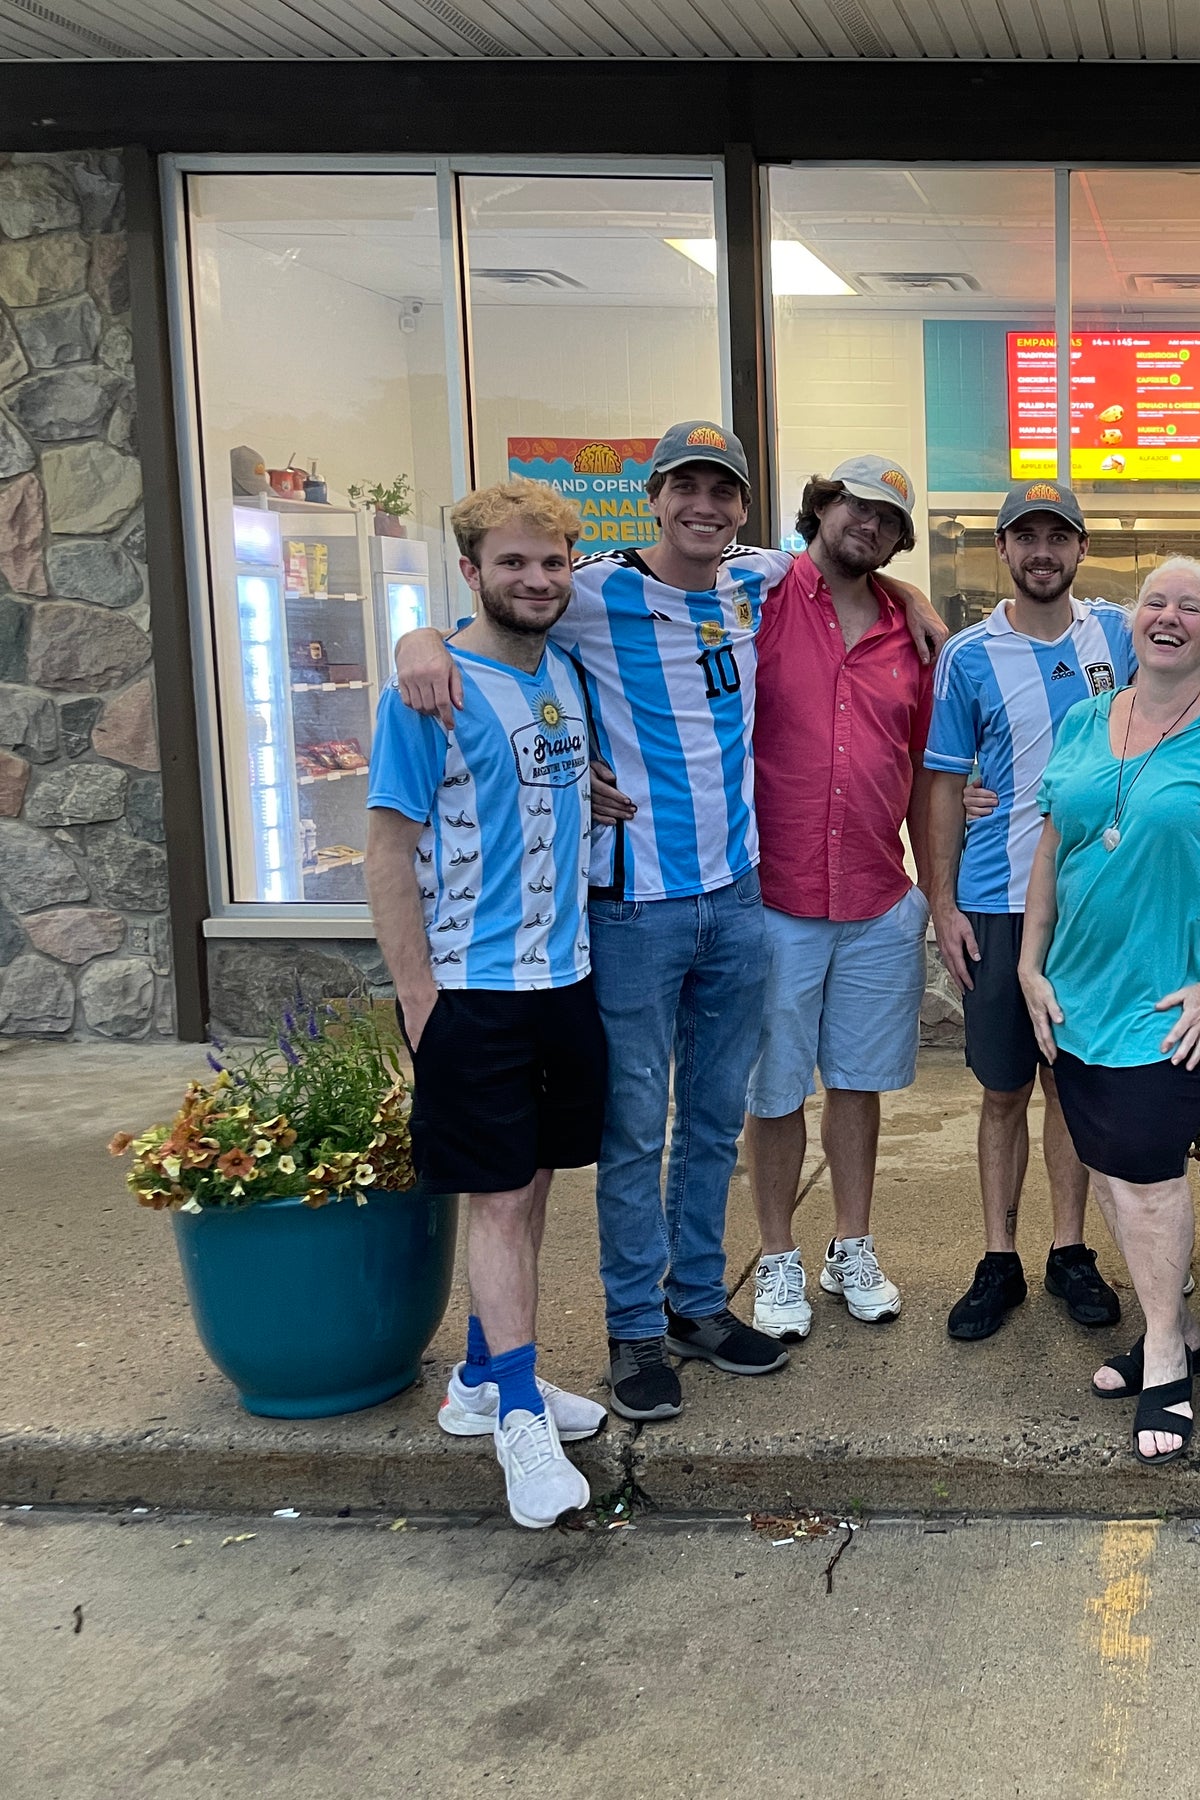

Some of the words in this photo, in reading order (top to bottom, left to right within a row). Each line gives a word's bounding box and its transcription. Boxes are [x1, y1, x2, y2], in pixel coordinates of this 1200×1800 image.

[1016, 339, 1082, 347] EMPANAS
[579, 449, 617, 473] BRAVA
[579, 521, 659, 542] ORE!!!
[695, 645, 741, 699] 10
[534, 734, 581, 765] Brava
